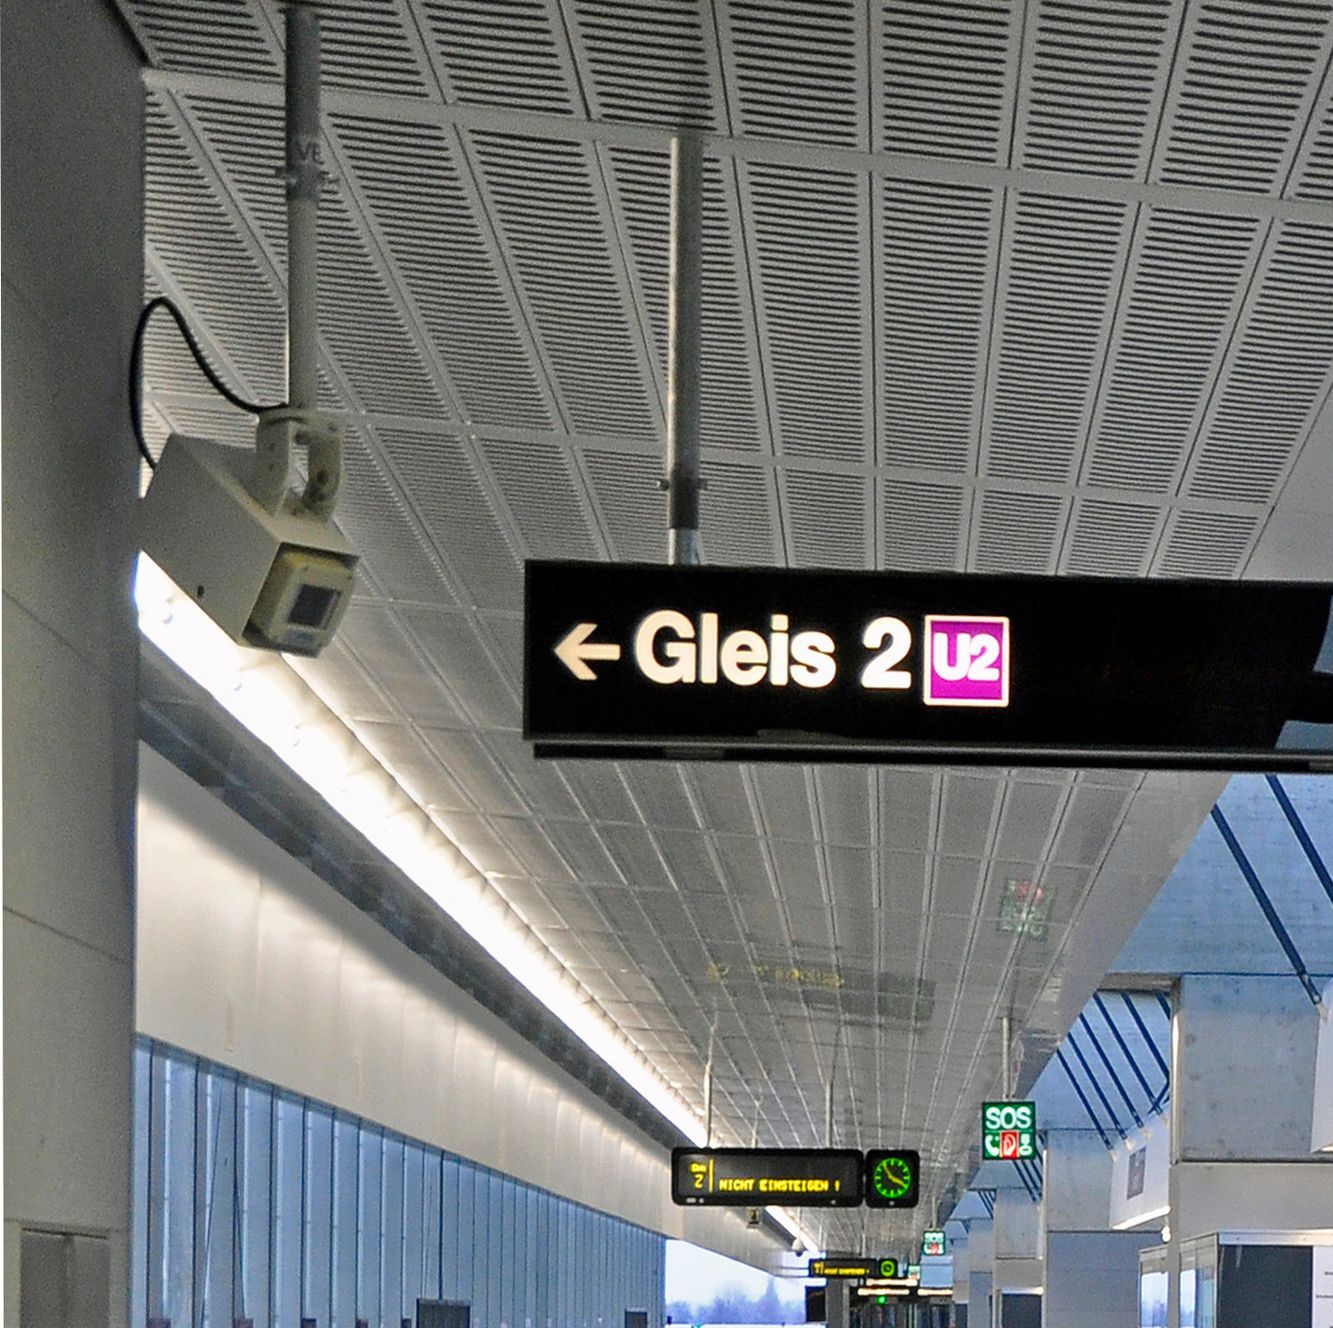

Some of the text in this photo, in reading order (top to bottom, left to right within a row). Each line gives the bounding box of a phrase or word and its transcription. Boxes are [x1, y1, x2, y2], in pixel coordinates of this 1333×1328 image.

[634, 610, 1000, 689] Gleis 2 U2
[985, 1106, 1032, 1130] SOS
[694, 1173, 704, 1189] 2
[718, 1178, 755, 1192] NICHT
[758, 1178, 829, 1192] EINSTEIGEN
